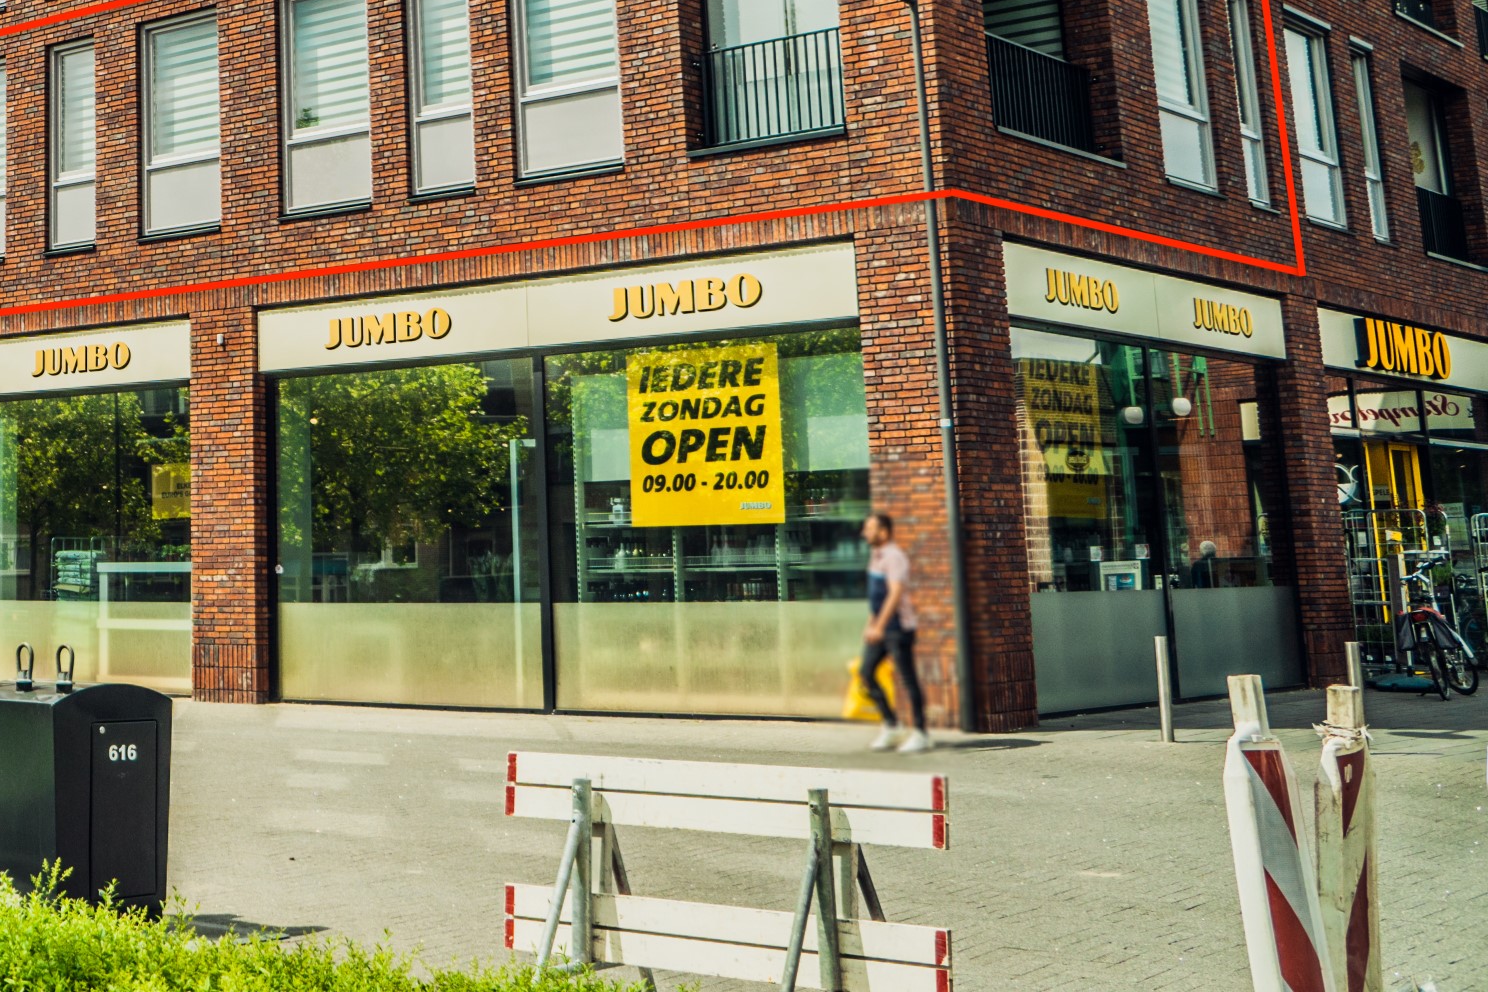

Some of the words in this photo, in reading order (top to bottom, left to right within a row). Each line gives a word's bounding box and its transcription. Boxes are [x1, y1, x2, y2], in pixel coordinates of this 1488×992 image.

[608, 273, 762, 322] JUMBO
[1045, 268, 1119, 314] JUMBO
[324, 307, 452, 350] JUMBO
[1193, 297, 1253, 338] JUMBO
[32, 341, 131, 377] JUMBO
[1362, 317, 1451, 380] JUMBO
[639, 358, 764, 394] IEDERE
[640, 394, 766, 423] ZONDAG
[641, 425, 767, 465] OPEN
[642, 473, 696, 493] 09.00
[713, 470, 769, 490] 20.00
[109, 744, 137, 761] 616
